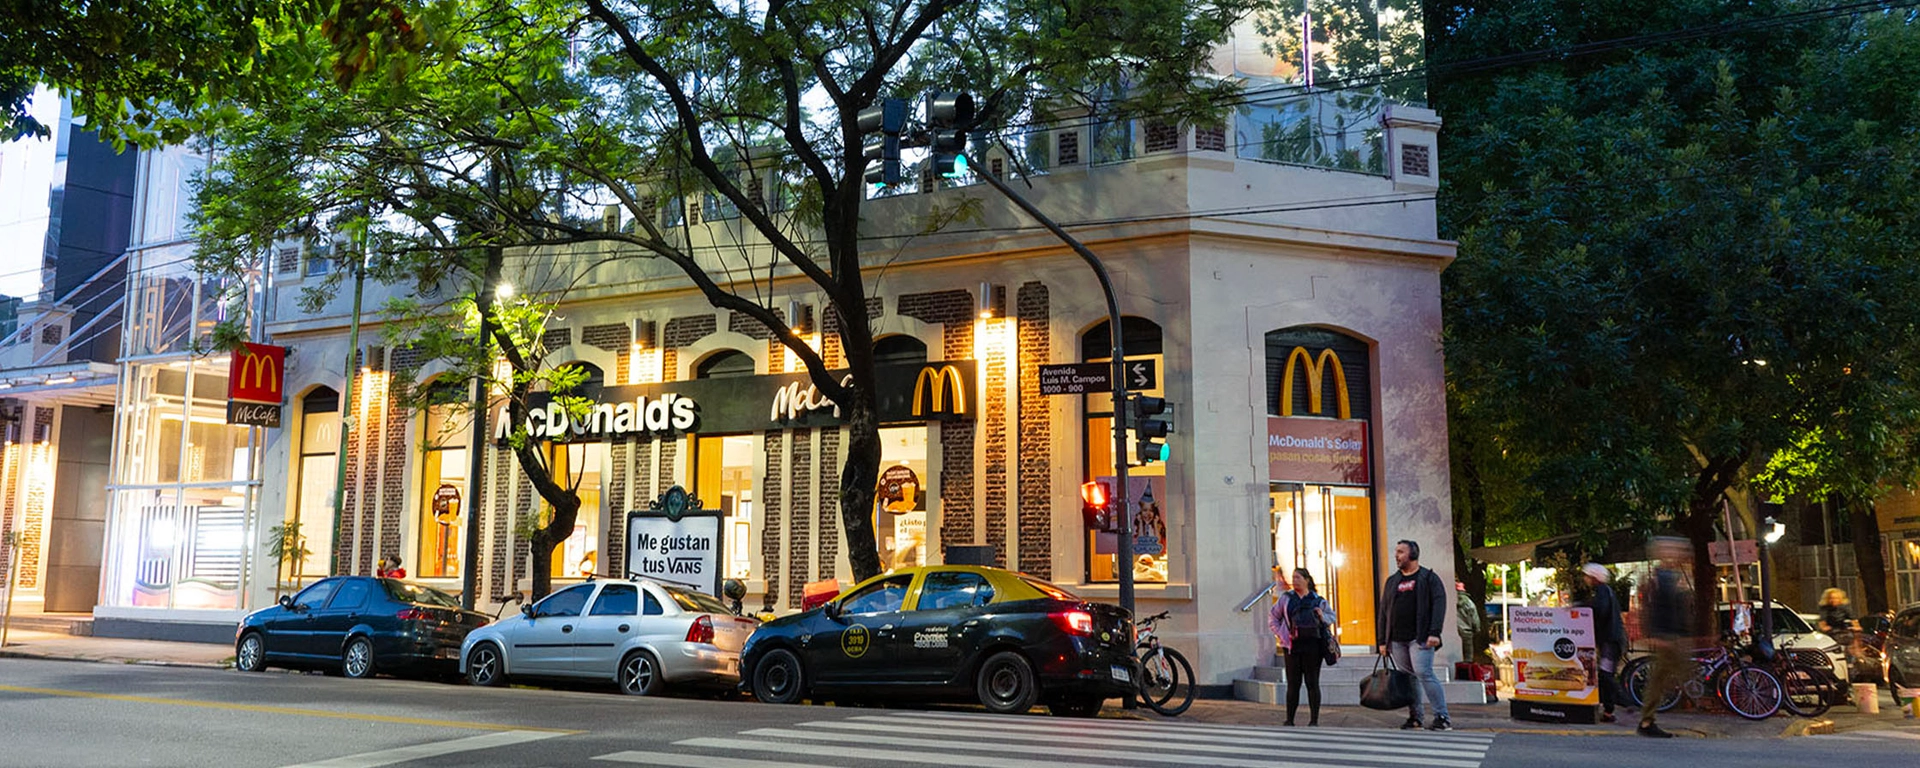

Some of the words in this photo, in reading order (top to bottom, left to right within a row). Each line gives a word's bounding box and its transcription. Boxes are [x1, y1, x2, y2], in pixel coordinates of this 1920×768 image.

[1042, 367, 1076, 376] Avenida
[1042, 377, 1059, 385] Luis
[1060, 376, 1071, 384] M.
[1072, 375, 1106, 385] Campos
[1043, 385, 1061, 393] 1000
[1068, 384, 1084, 393] 900
[234, 405, 277, 425] McCafé
[1269, 434, 1333, 450] McDonald's
[637, 533, 658, 550] Me
[660, 534, 710, 555] gustan
[642, 557, 665, 573] tus
[667, 557, 703, 574] VANS
[914, 632, 948, 642] Premier
